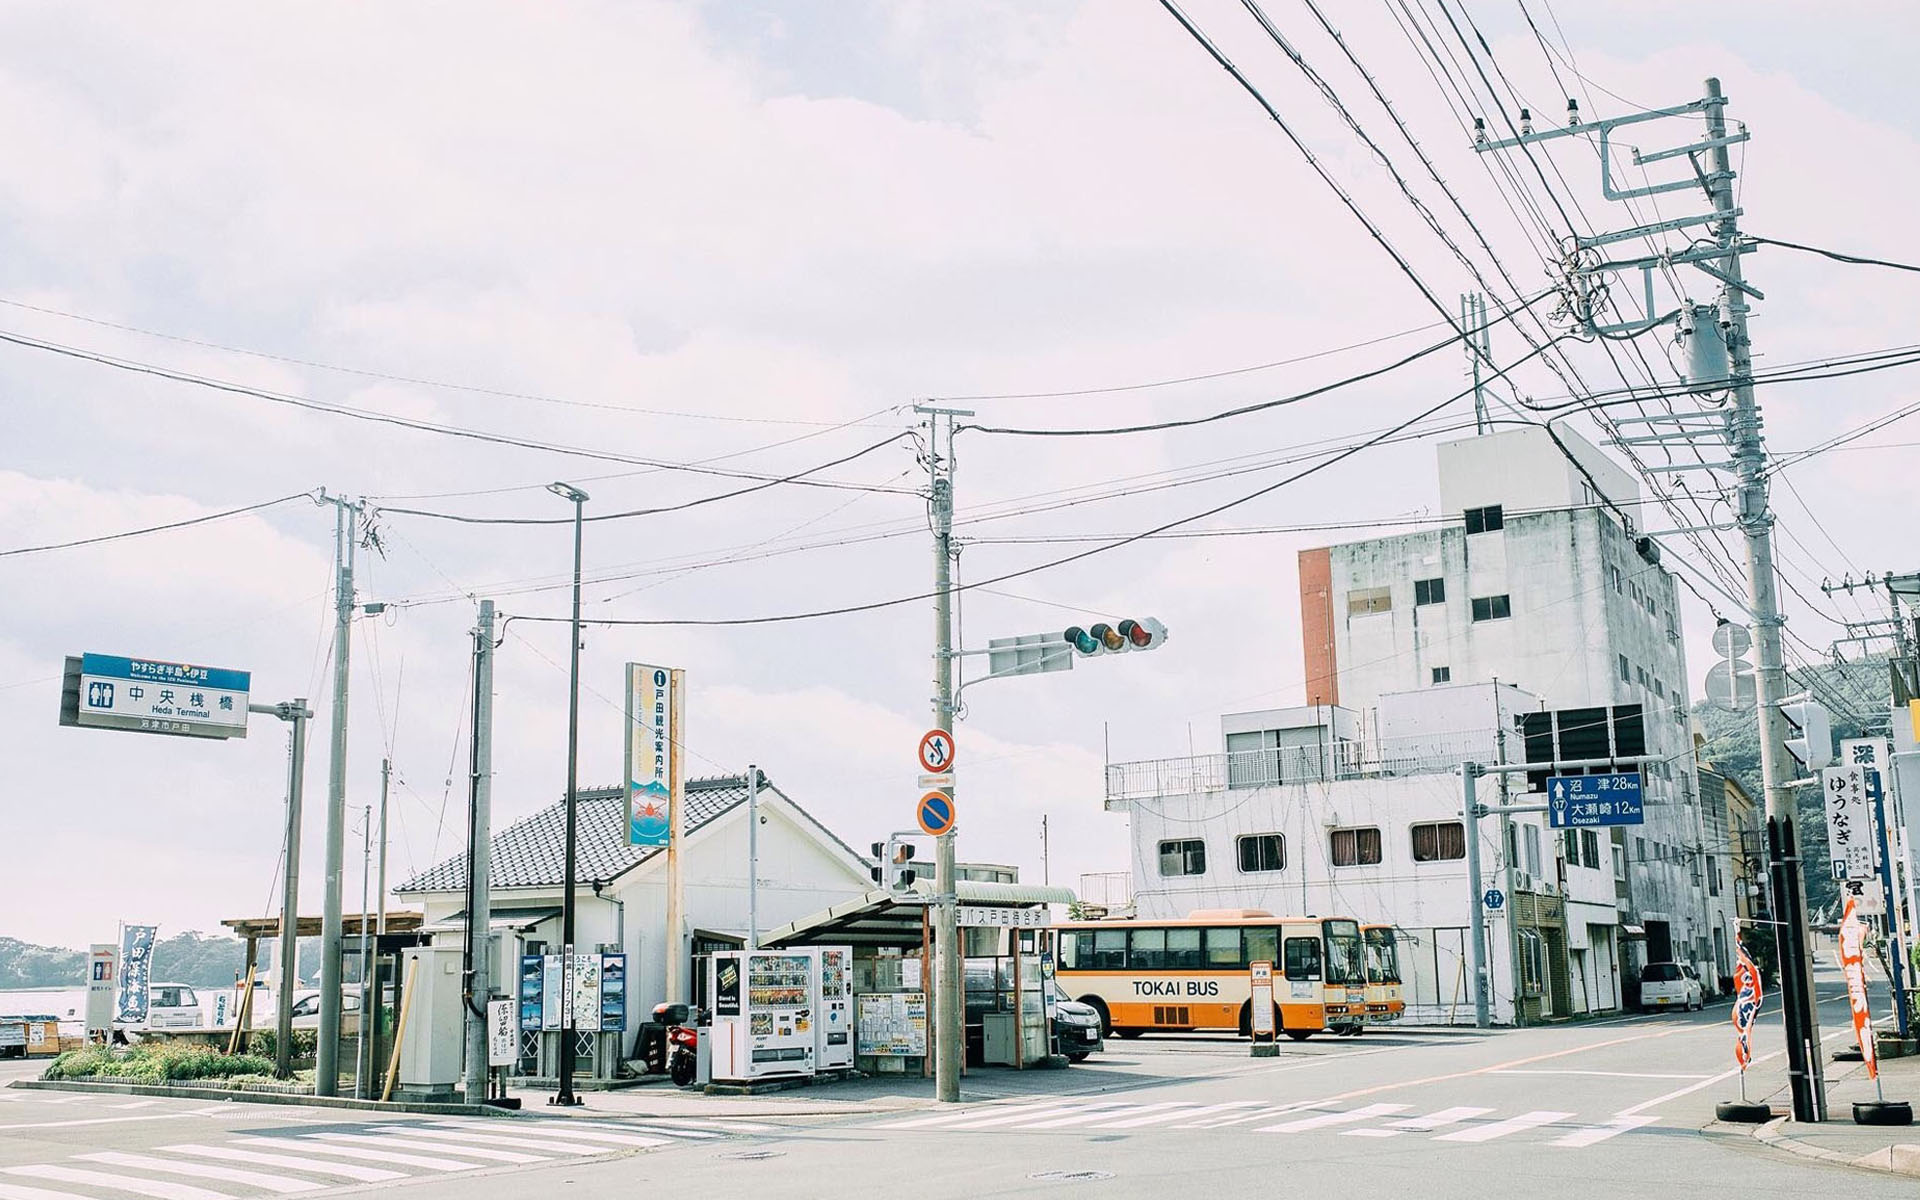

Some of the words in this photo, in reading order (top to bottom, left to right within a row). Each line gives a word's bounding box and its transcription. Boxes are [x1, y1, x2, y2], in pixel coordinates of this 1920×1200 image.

[151, 705, 173, 715] Heda
[176, 707, 211, 719] Terminal
[654, 688, 665, 779] 戸田観光案内所
[1569, 778, 1611, 793] 沼津
[1849, 771, 1862, 805] 食事処
[1555, 800, 1564, 809] 17
[1571, 803, 1612, 816] 大瀬崎
[1830, 776, 1852, 846] ゆうなぎ
[1572, 816, 1600, 824] Osezaki
[1835, 862, 1845, 878] P
[1487, 894, 1500, 903] 17
[1133, 981, 1180, 995] TOKAI
[1187, 981, 1218, 996] BUS
